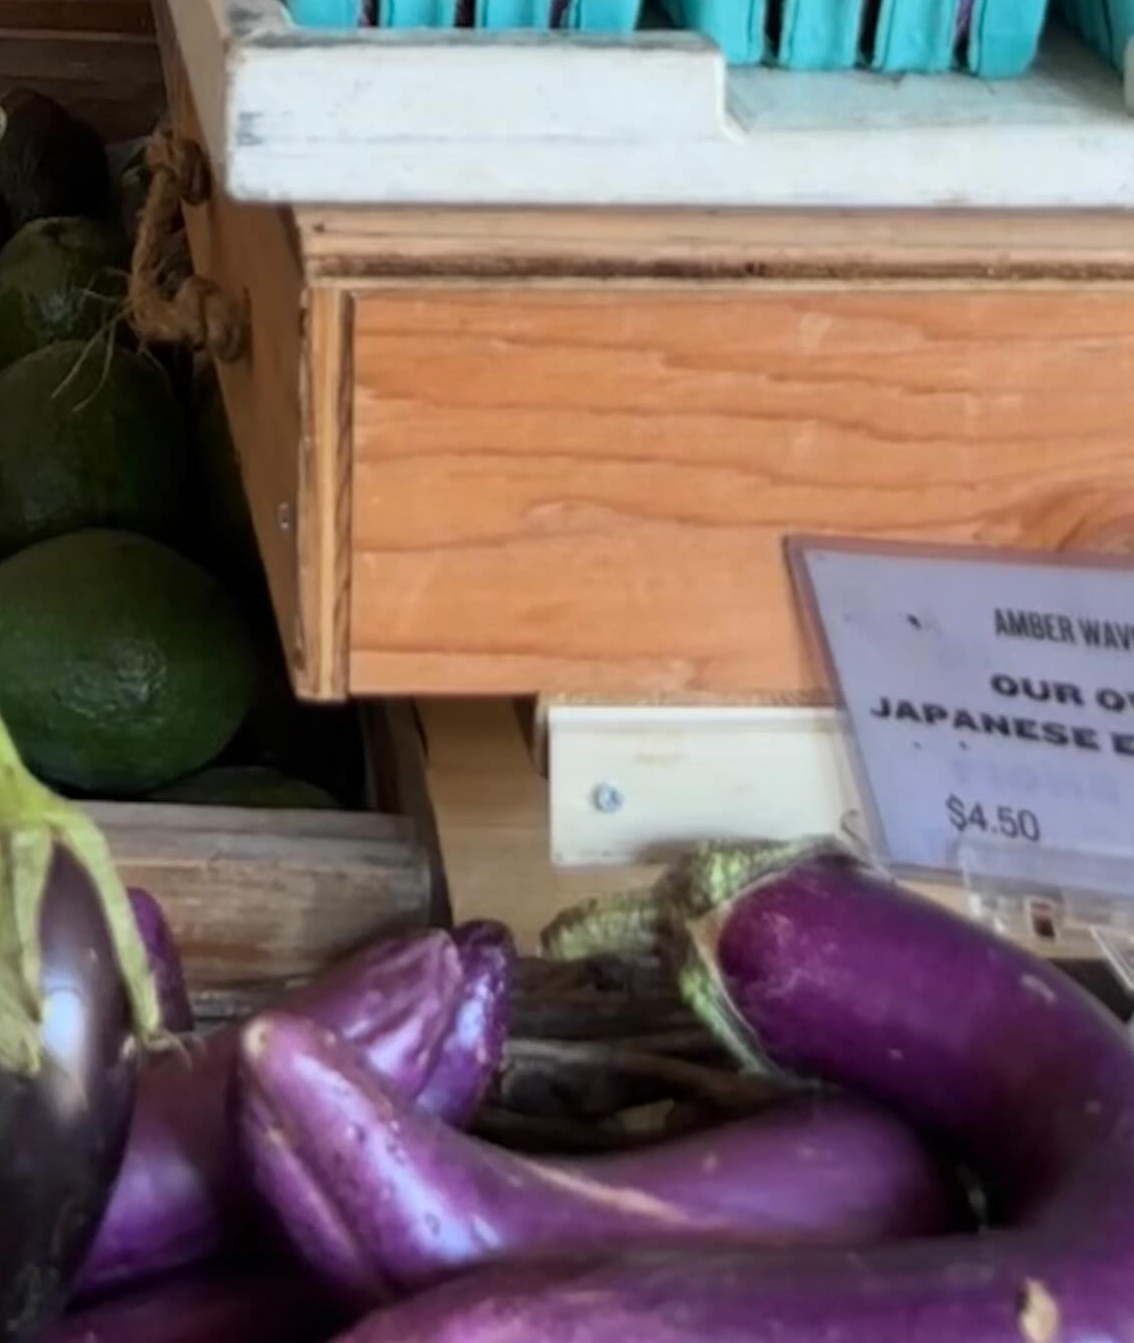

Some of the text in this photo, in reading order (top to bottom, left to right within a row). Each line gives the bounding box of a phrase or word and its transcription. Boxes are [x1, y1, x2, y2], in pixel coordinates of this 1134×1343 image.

[994, 607, 1134, 651] AMBER WAV
[990, 673, 1134, 713] OUR O
[869, 695, 1102, 752] JAPANESE
[945, 792, 1041, 843] $4.50
